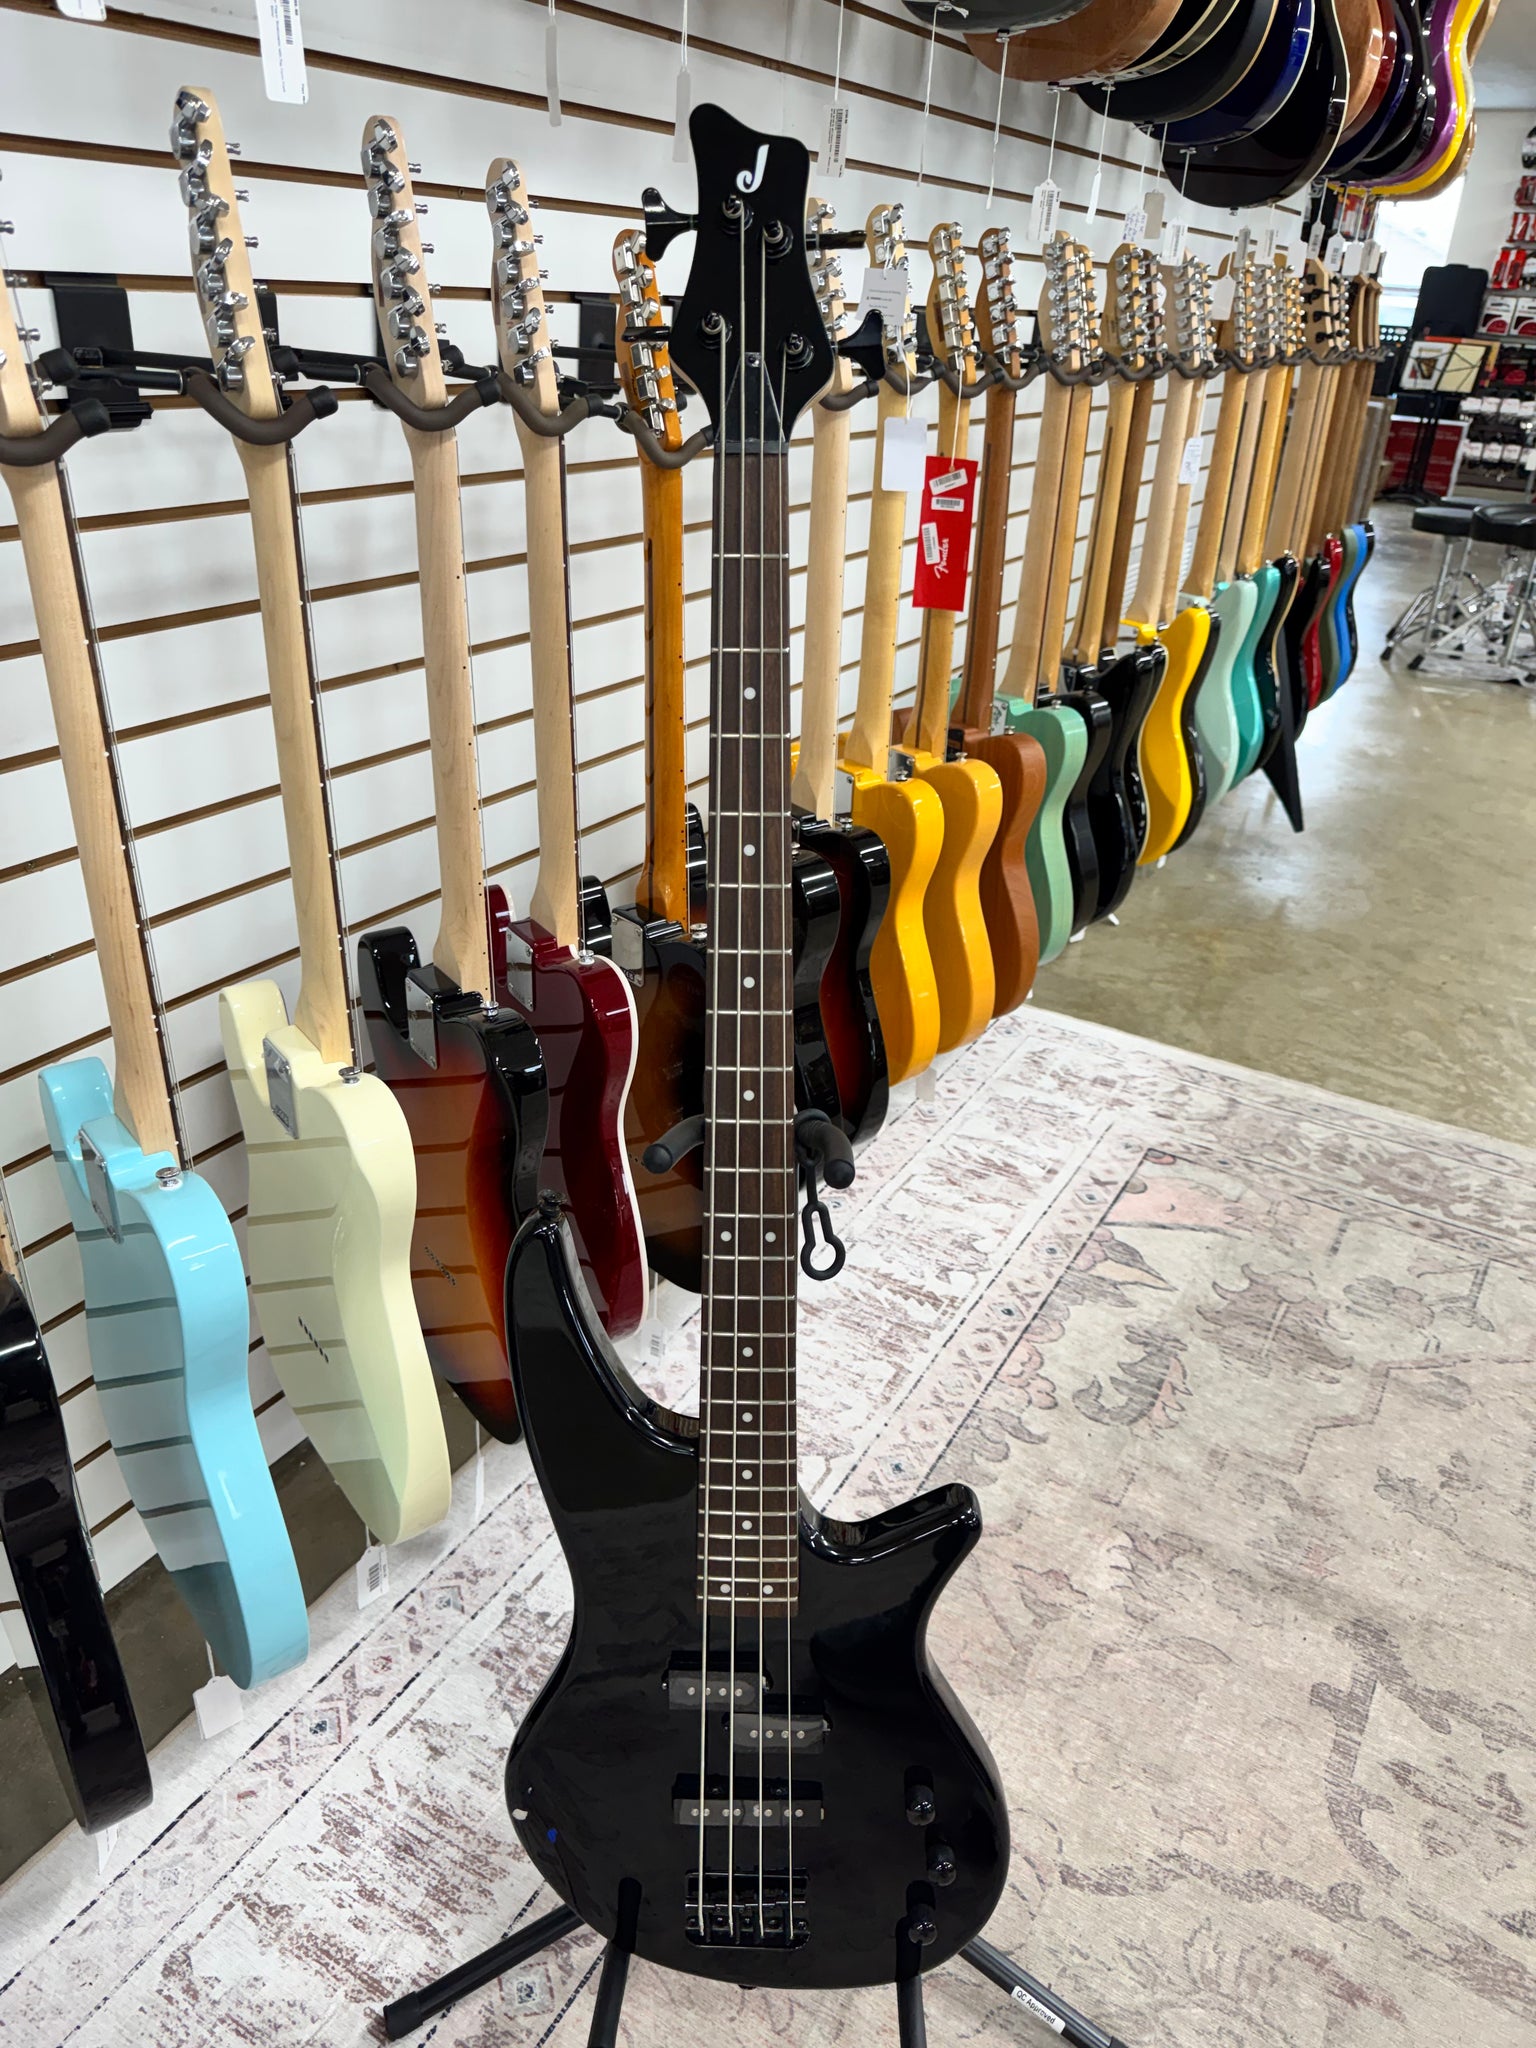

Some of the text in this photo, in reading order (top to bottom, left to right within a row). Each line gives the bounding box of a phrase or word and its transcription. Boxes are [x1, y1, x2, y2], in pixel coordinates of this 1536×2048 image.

[736, 144, 770, 193] J
[933, 538, 949, 579] Fender
[1016, 1990, 1056, 2025] QC Approved
